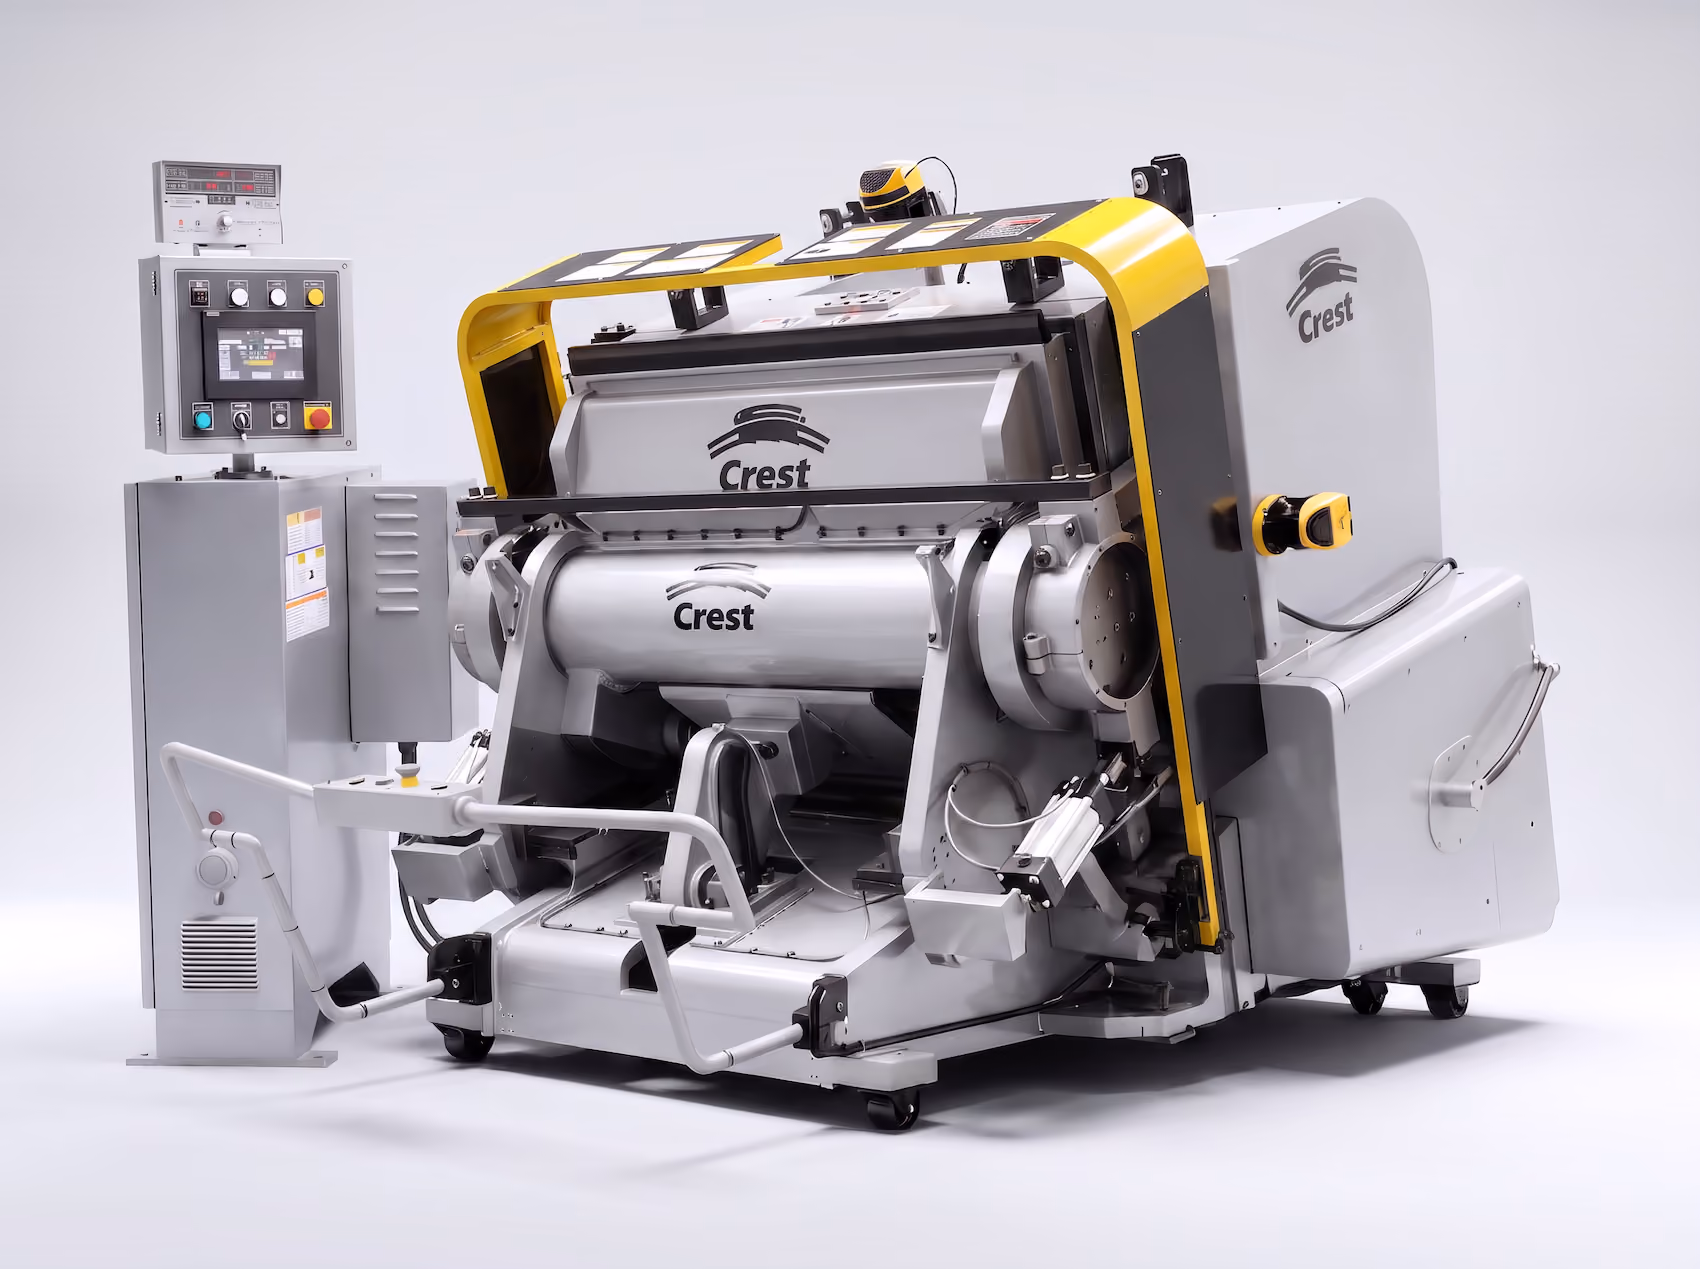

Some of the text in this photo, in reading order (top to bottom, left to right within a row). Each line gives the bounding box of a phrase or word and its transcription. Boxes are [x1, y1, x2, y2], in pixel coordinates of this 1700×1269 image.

[1298, 291, 1354, 344] Crest
[719, 458, 811, 491] Crest
[673, 602, 754, 631] Crest
